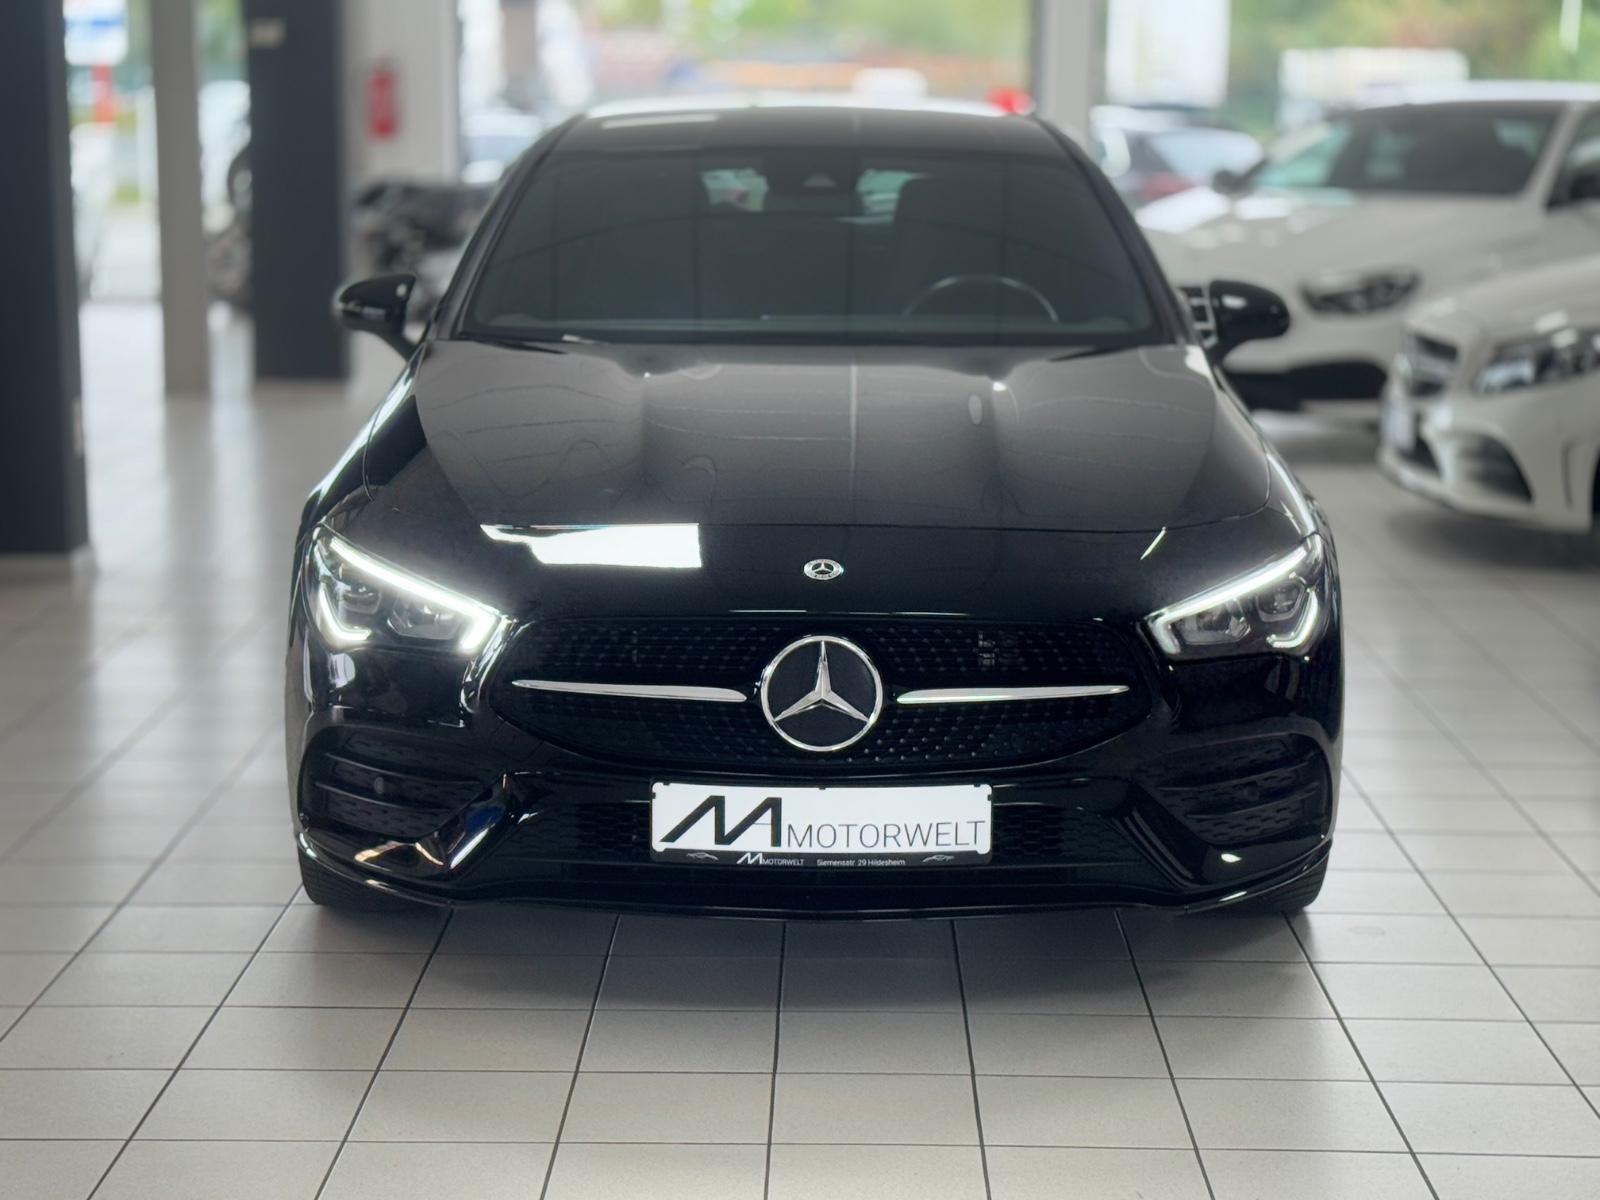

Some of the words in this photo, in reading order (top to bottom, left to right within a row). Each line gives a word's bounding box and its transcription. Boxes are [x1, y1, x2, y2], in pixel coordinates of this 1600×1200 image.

[787, 820, 986, 848] MOTORWELT
[763, 858, 805, 866] MOTORWELT
[857, 859, 867, 867] 29
[868, 858, 906, 867] Hildesheim
